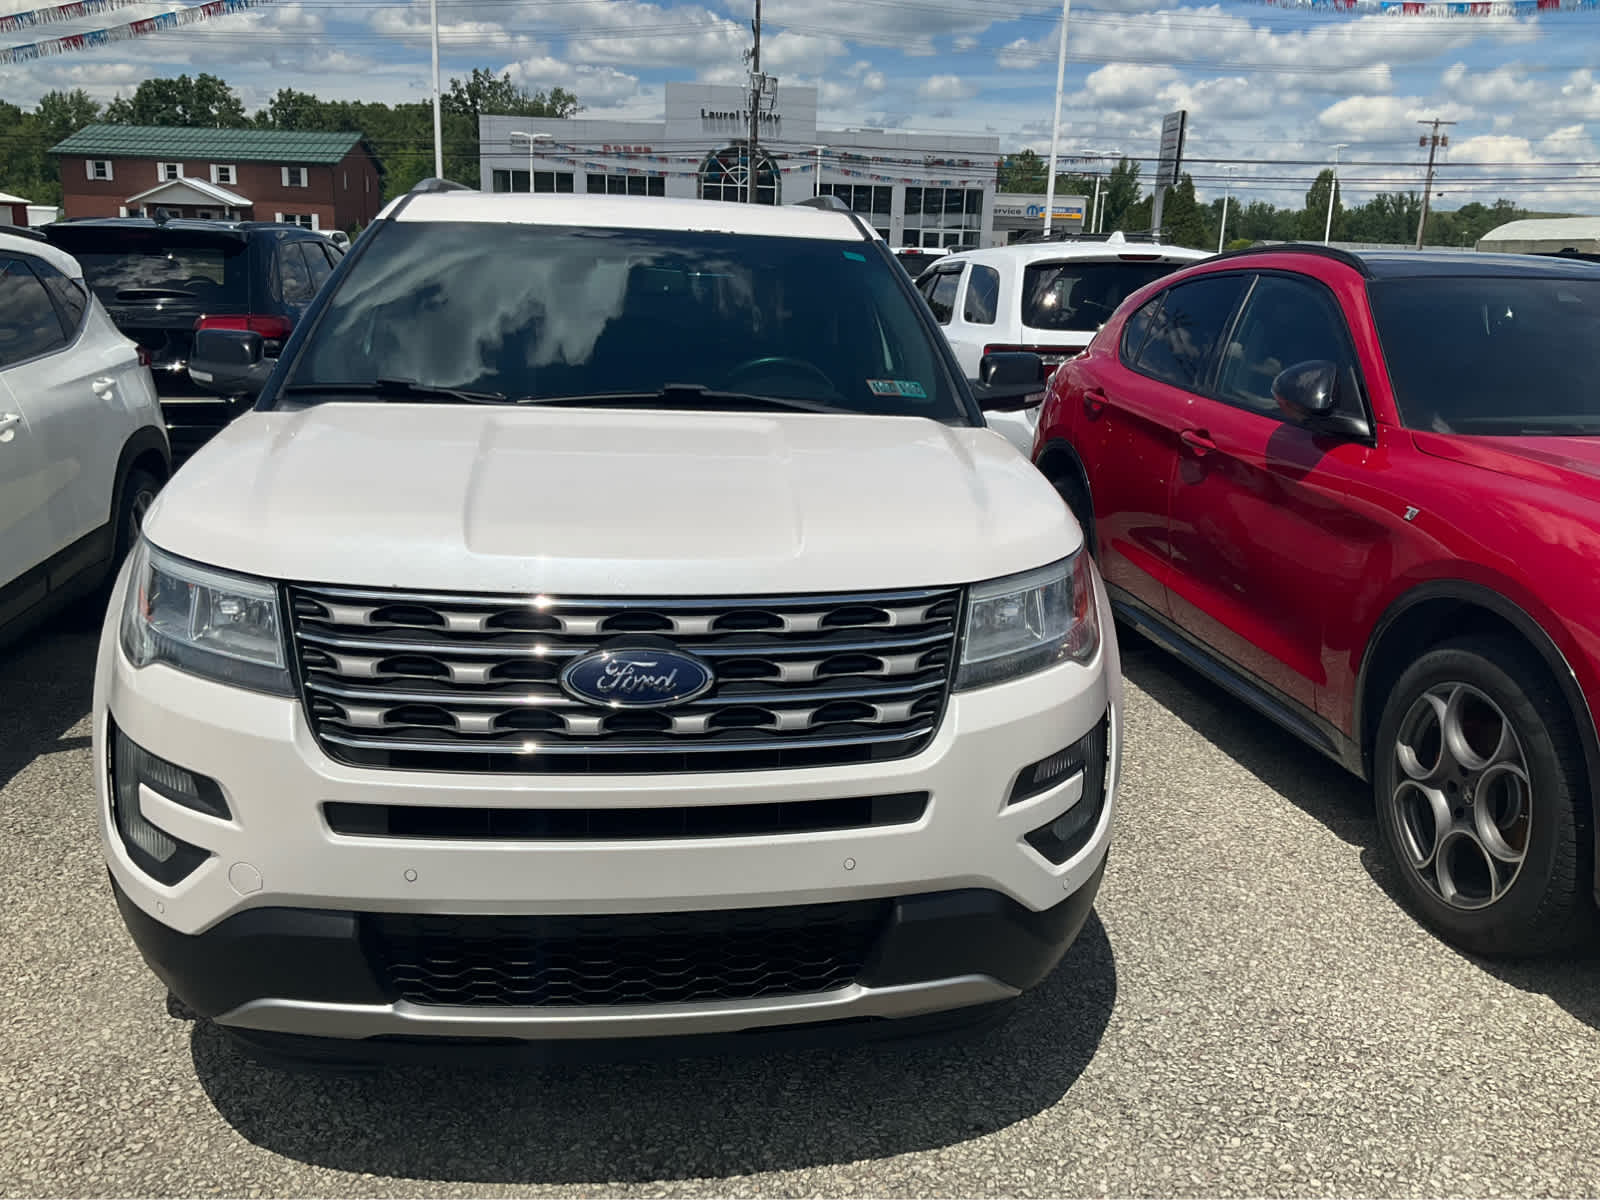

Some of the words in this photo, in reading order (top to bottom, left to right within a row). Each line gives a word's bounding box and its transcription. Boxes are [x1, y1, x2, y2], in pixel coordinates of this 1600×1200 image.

[701, 108, 740, 121] Laurel
[743, 110, 781, 124] Vlley
[993, 207, 1022, 215] ervice
[596, 659, 678, 693] Ford
